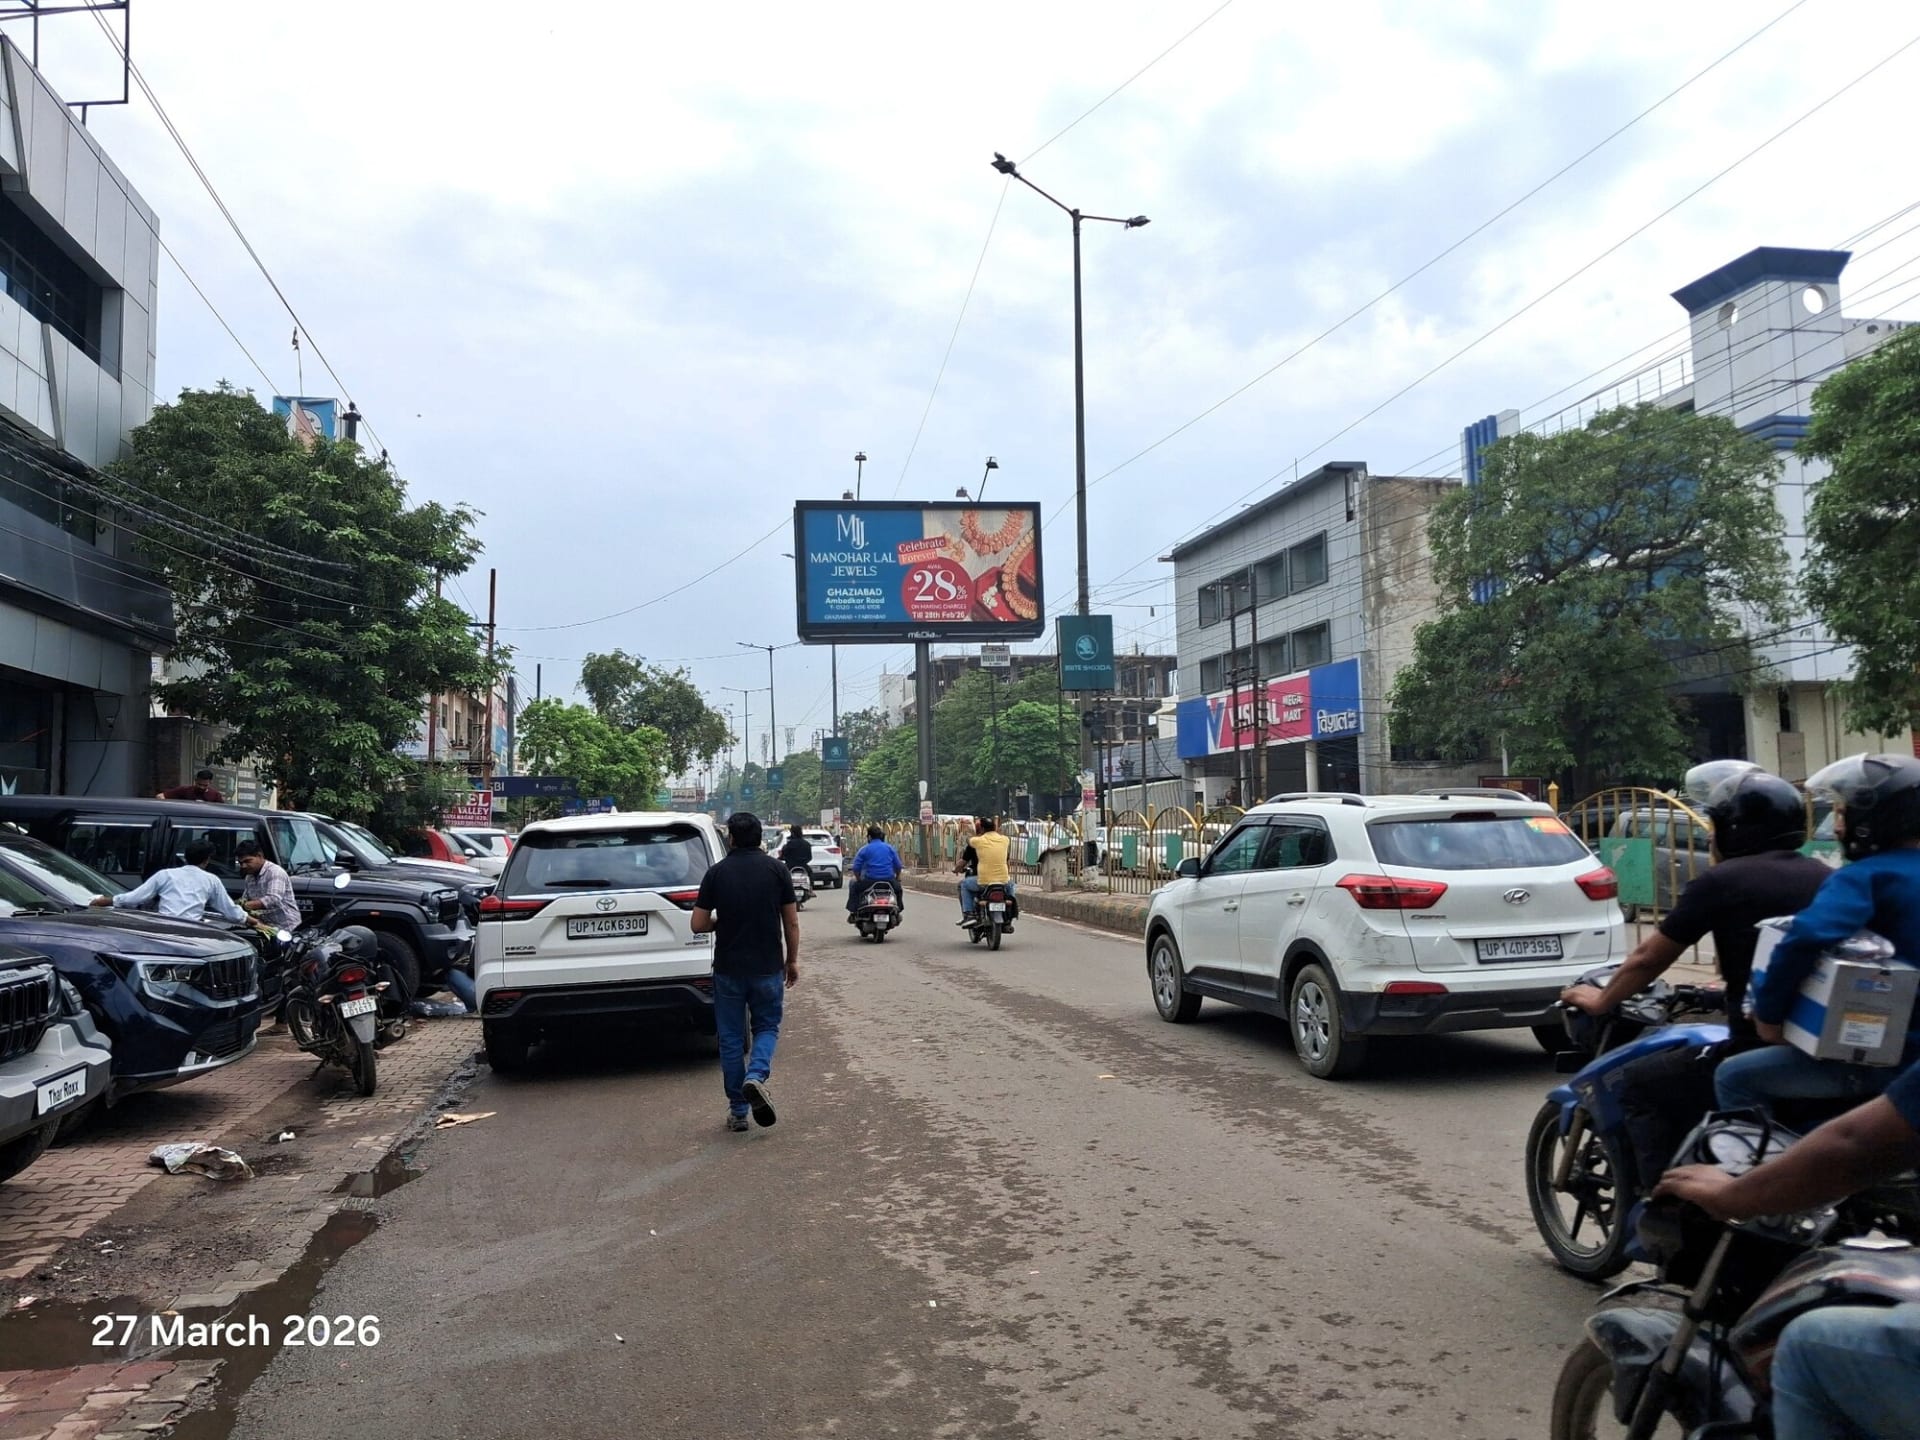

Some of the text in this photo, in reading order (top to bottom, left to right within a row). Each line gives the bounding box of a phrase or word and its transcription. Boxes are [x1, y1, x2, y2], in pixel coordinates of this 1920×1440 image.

[898, 538, 945, 553] Celebrate
[810, 552, 897, 563] MANOHAR LAL
[901, 550, 937, 563] Forever
[831, 566, 878, 577] JEWELS
[913, 569, 957, 601] 28
[827, 588, 882, 597] GHAZIABAD
[1282, 694, 1303, 706] MEGA
[1283, 708, 1304, 721] MART
[457, 806, 489, 815] VALLEY
[576, 918, 645, 933] UP14GK6300
[1485, 939, 1559, 956] UP14DP3963
[48, 1087, 62, 1106] Thar
